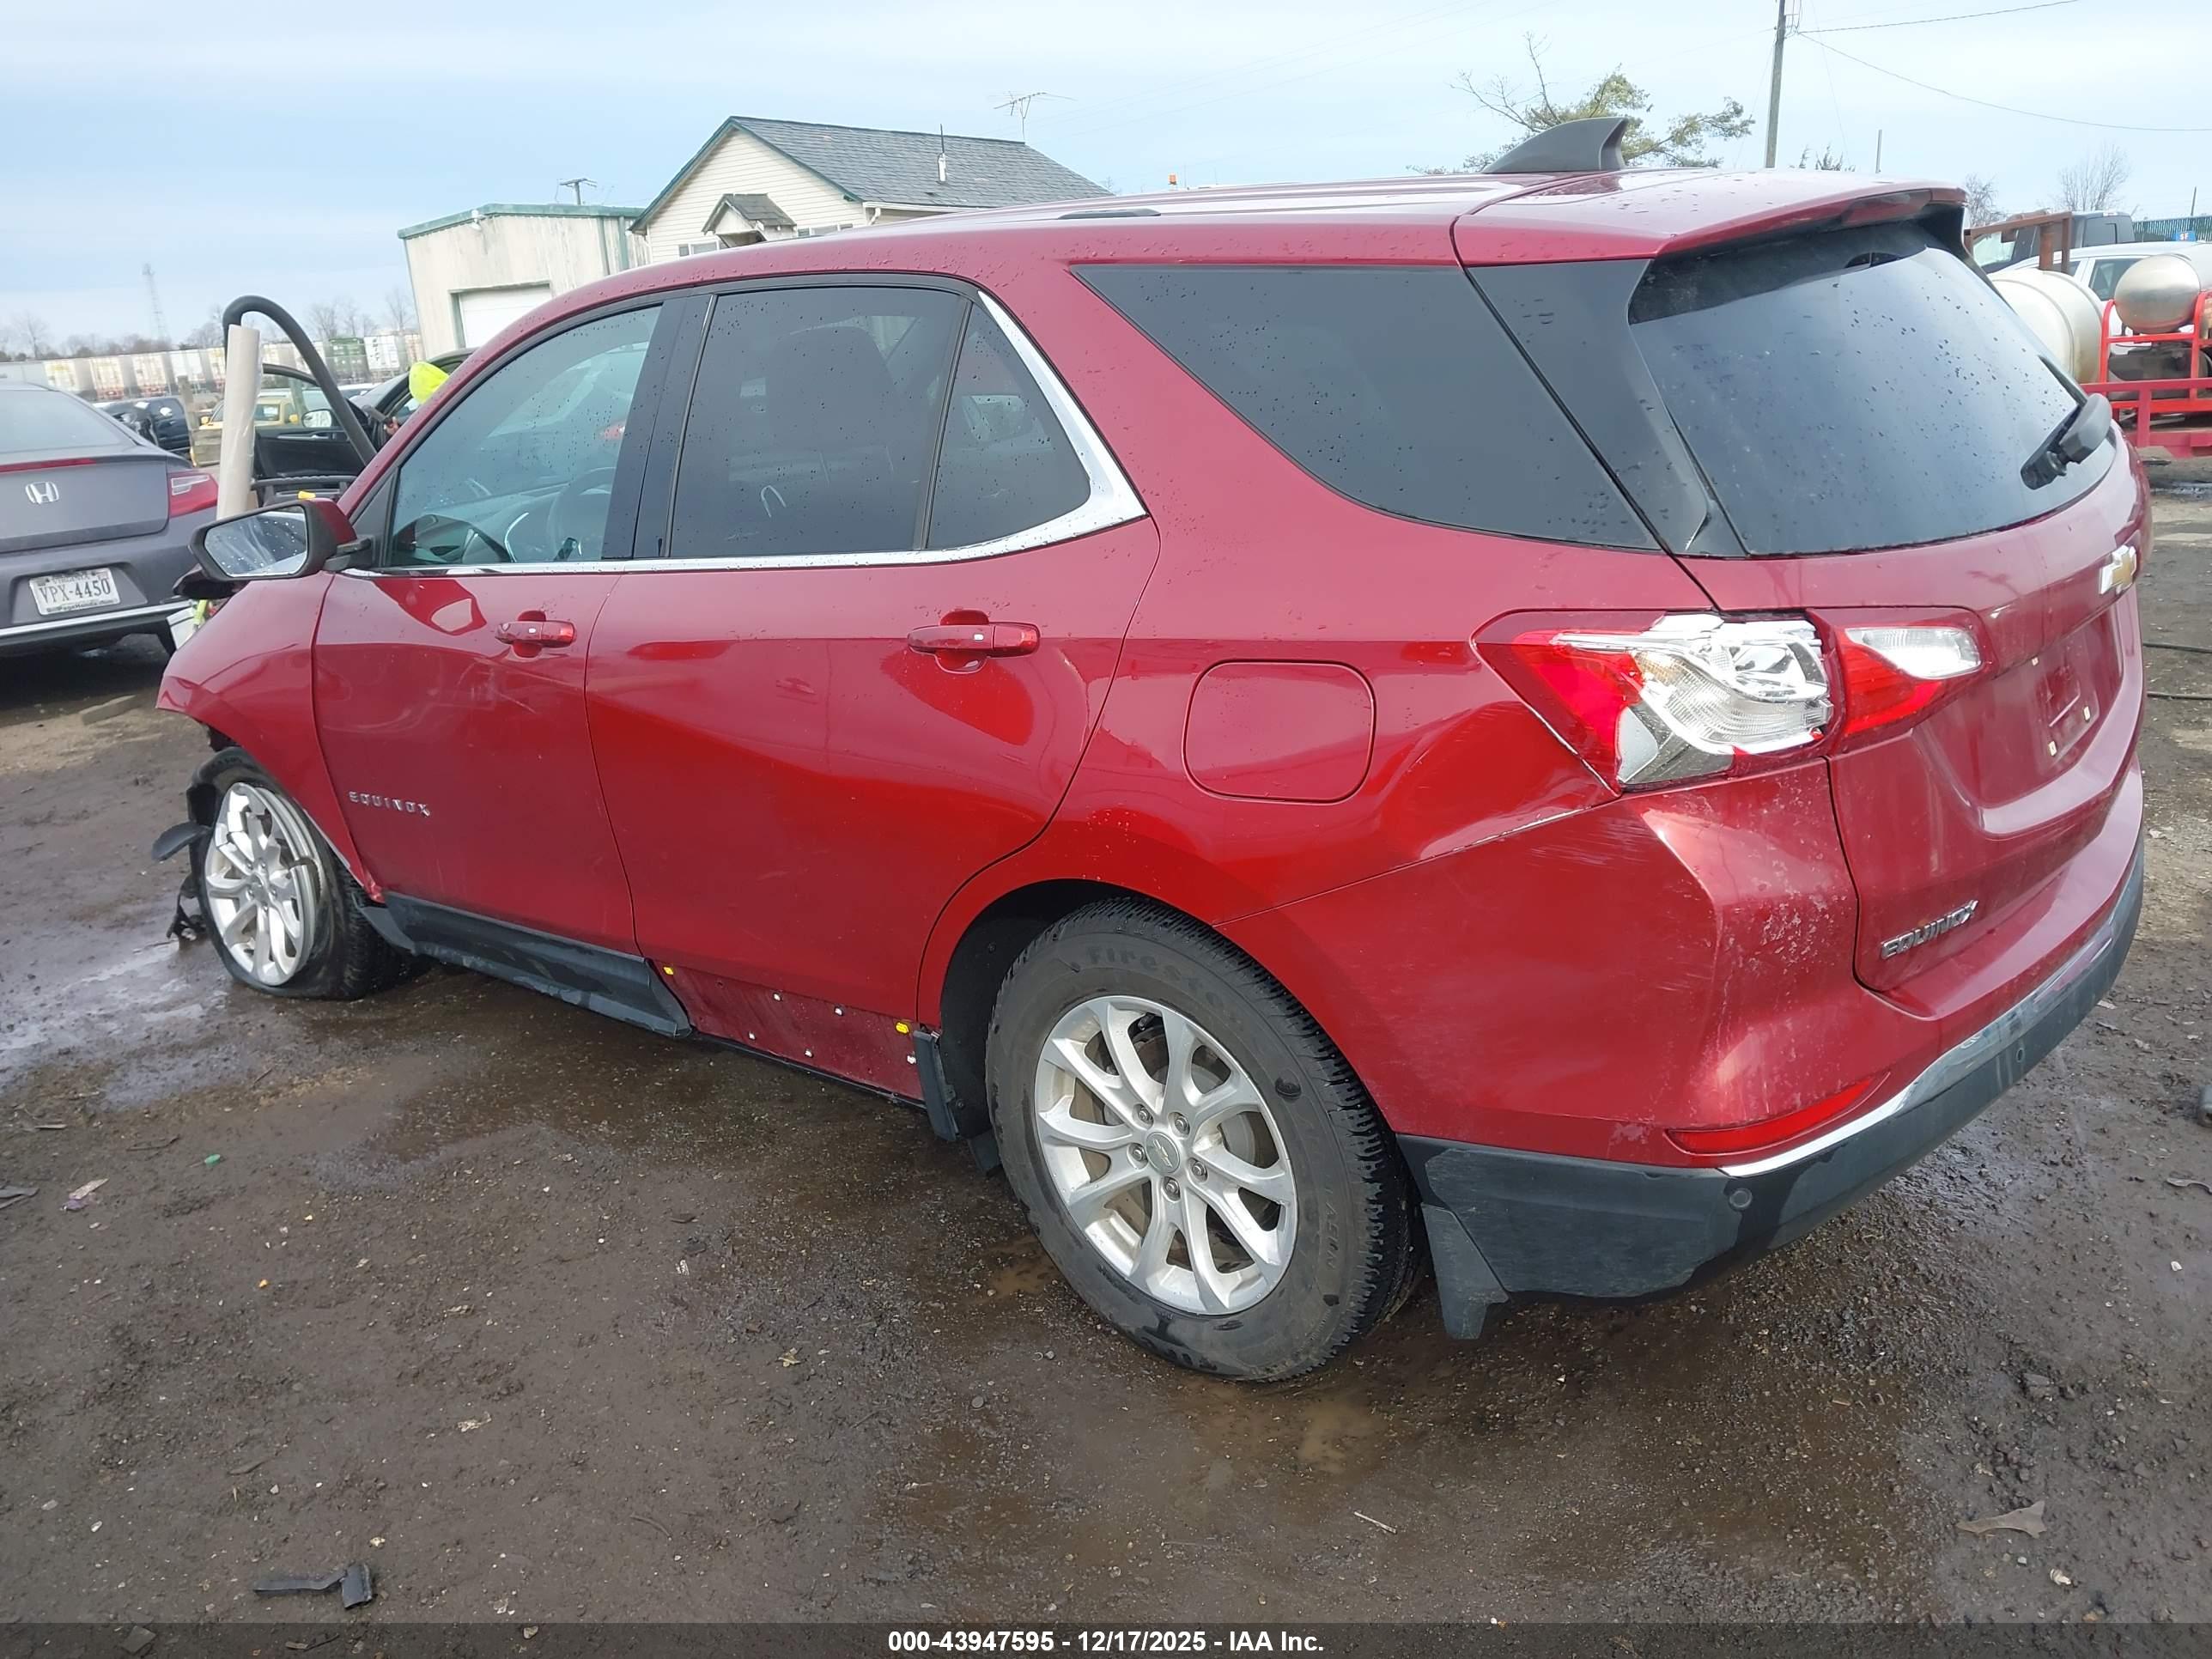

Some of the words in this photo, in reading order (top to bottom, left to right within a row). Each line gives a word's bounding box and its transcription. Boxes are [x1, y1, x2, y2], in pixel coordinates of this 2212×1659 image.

[39, 578, 111, 603] VPX-4450
[348, 791, 430, 817] EQUINOX
[1881, 899, 1978, 960] EQUINOX
